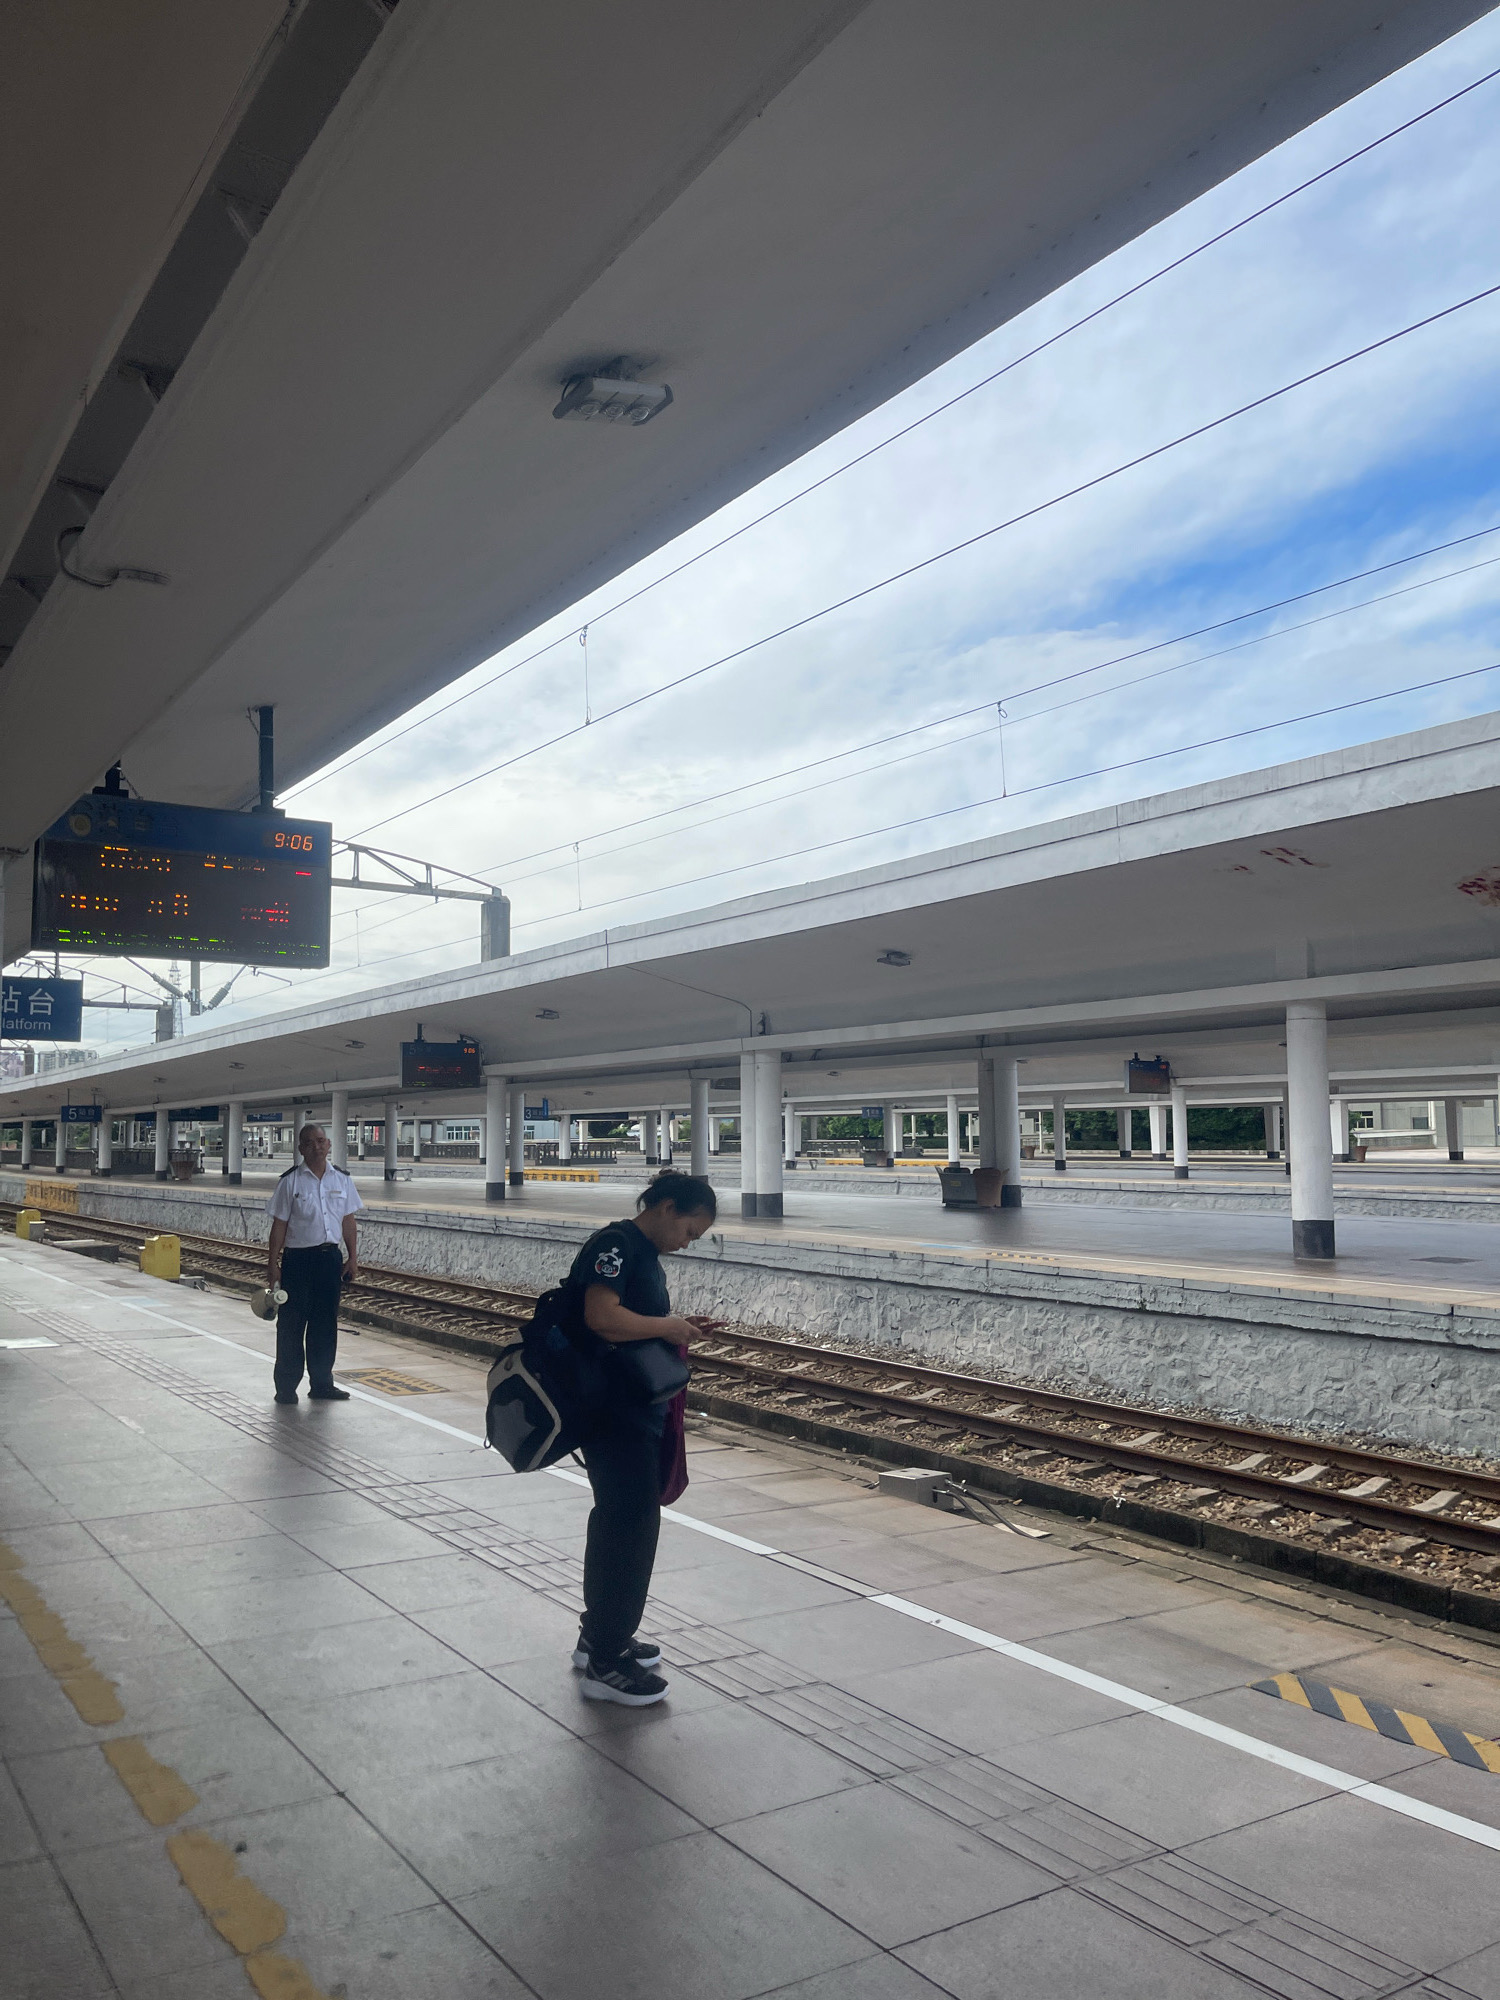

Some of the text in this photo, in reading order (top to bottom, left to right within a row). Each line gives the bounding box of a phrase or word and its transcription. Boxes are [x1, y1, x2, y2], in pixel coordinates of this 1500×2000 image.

[274, 832, 313, 851] 9:06
[2, 1018, 51, 1031] latform
[68, 1107, 78, 1120] 5
[525, 1108, 532, 1119] 3
